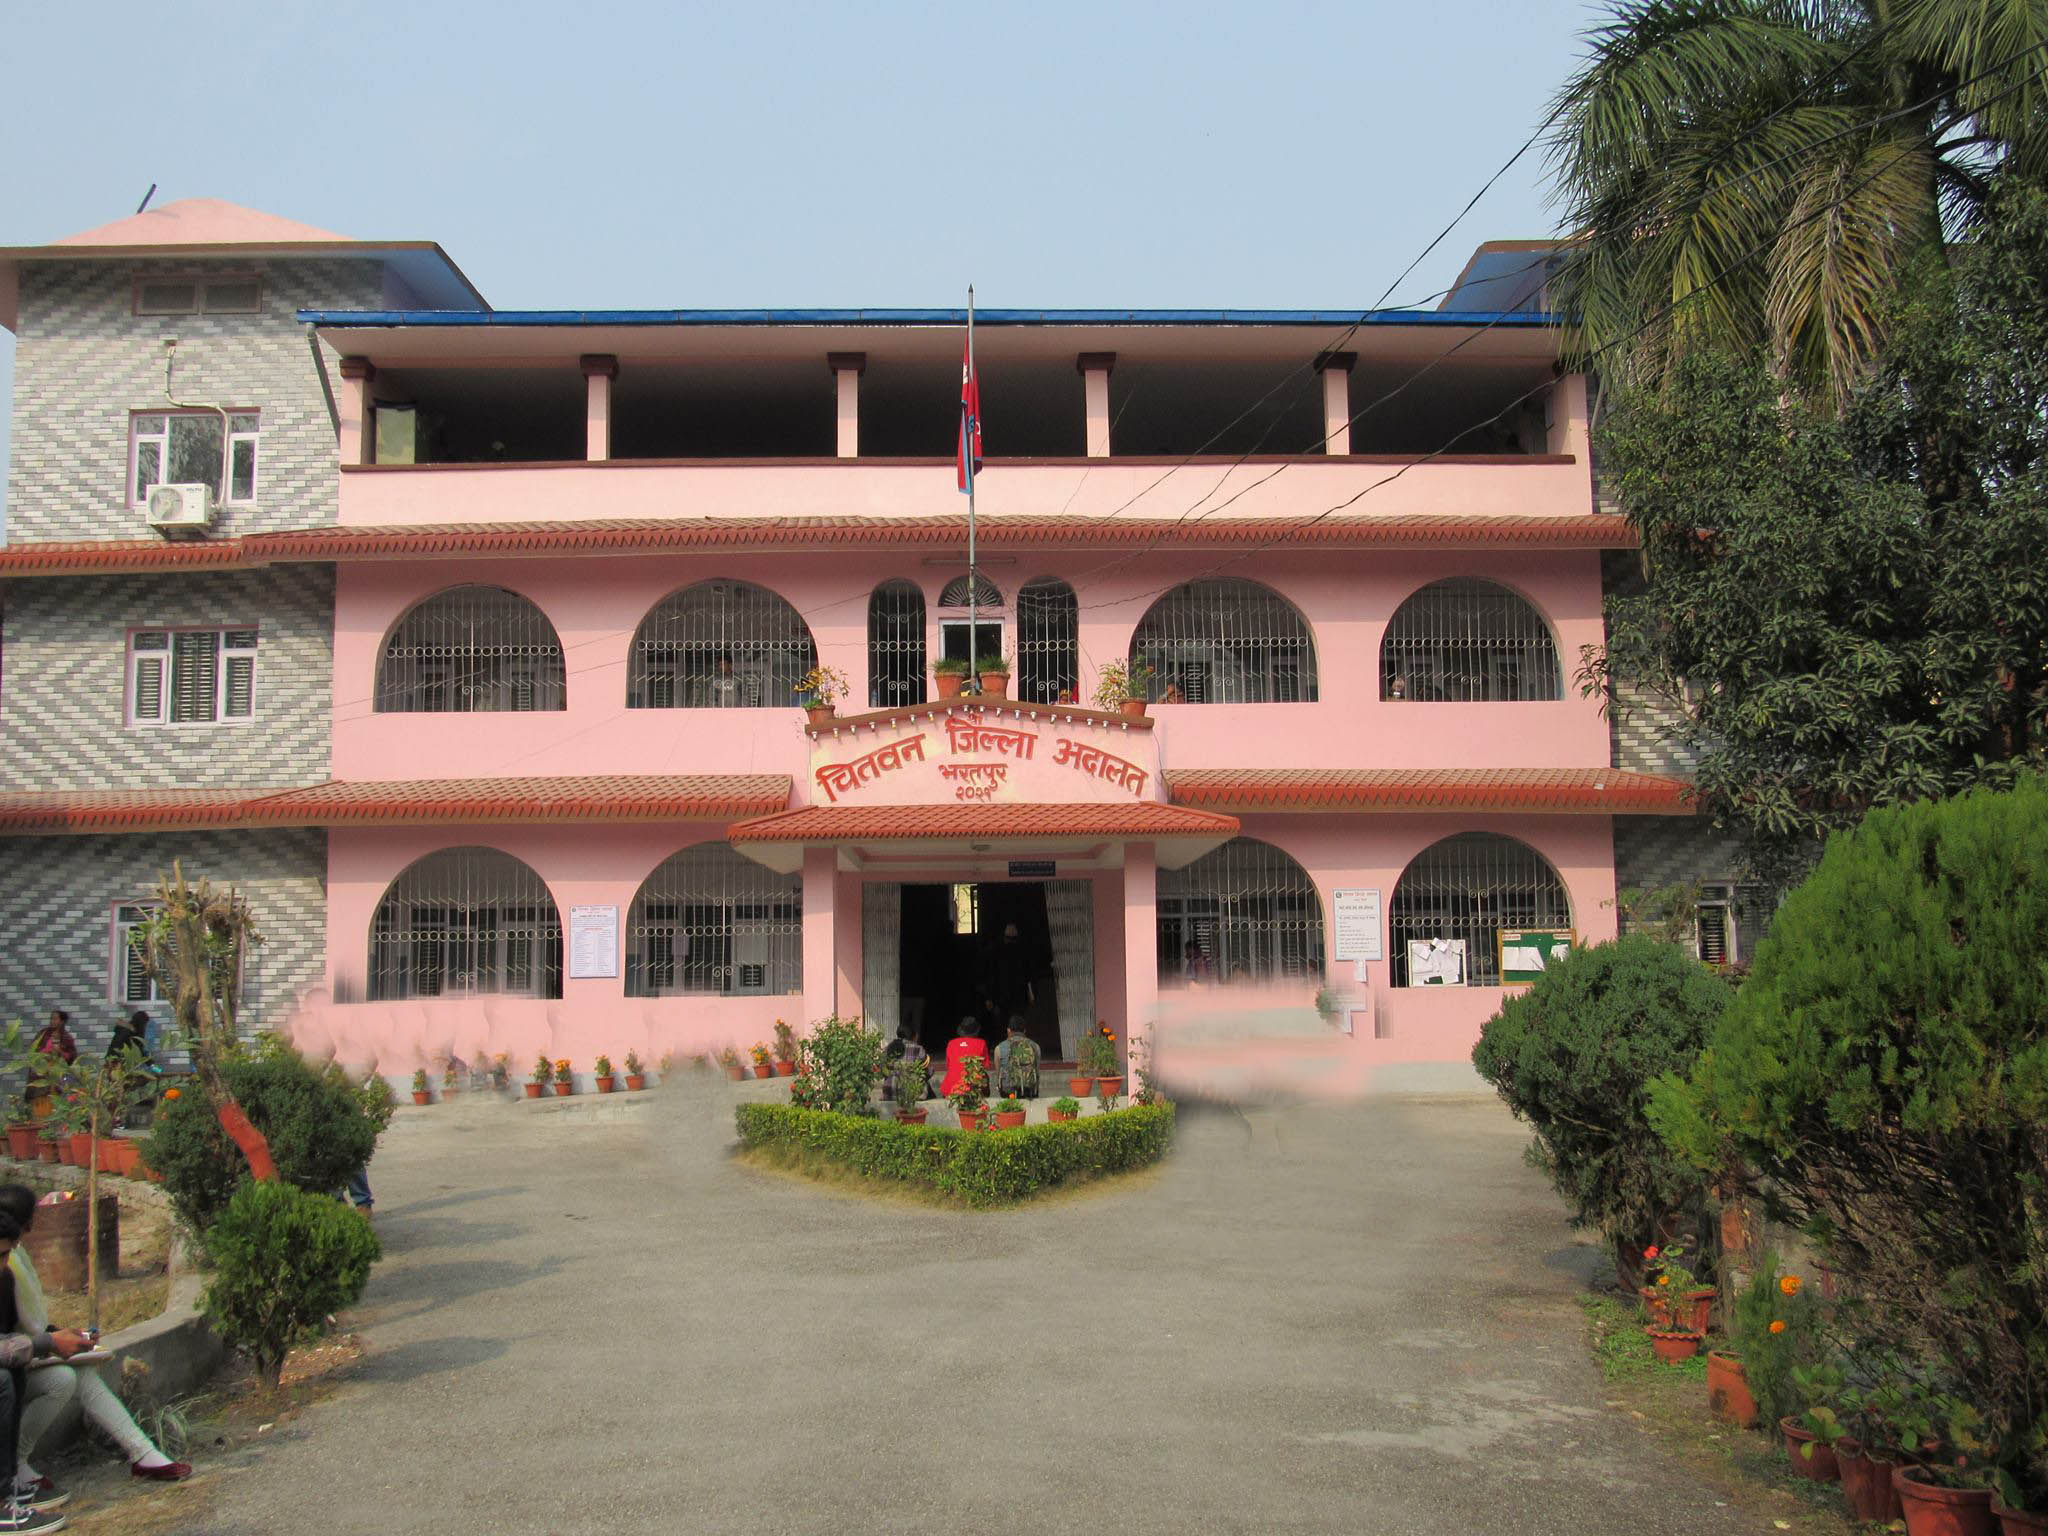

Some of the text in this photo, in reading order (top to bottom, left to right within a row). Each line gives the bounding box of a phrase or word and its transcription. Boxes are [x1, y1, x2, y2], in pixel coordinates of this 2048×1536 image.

[815, 716, 1149, 803] चितवन जिल्ला अदालत
[938, 763, 1009, 792] भरतपुर
